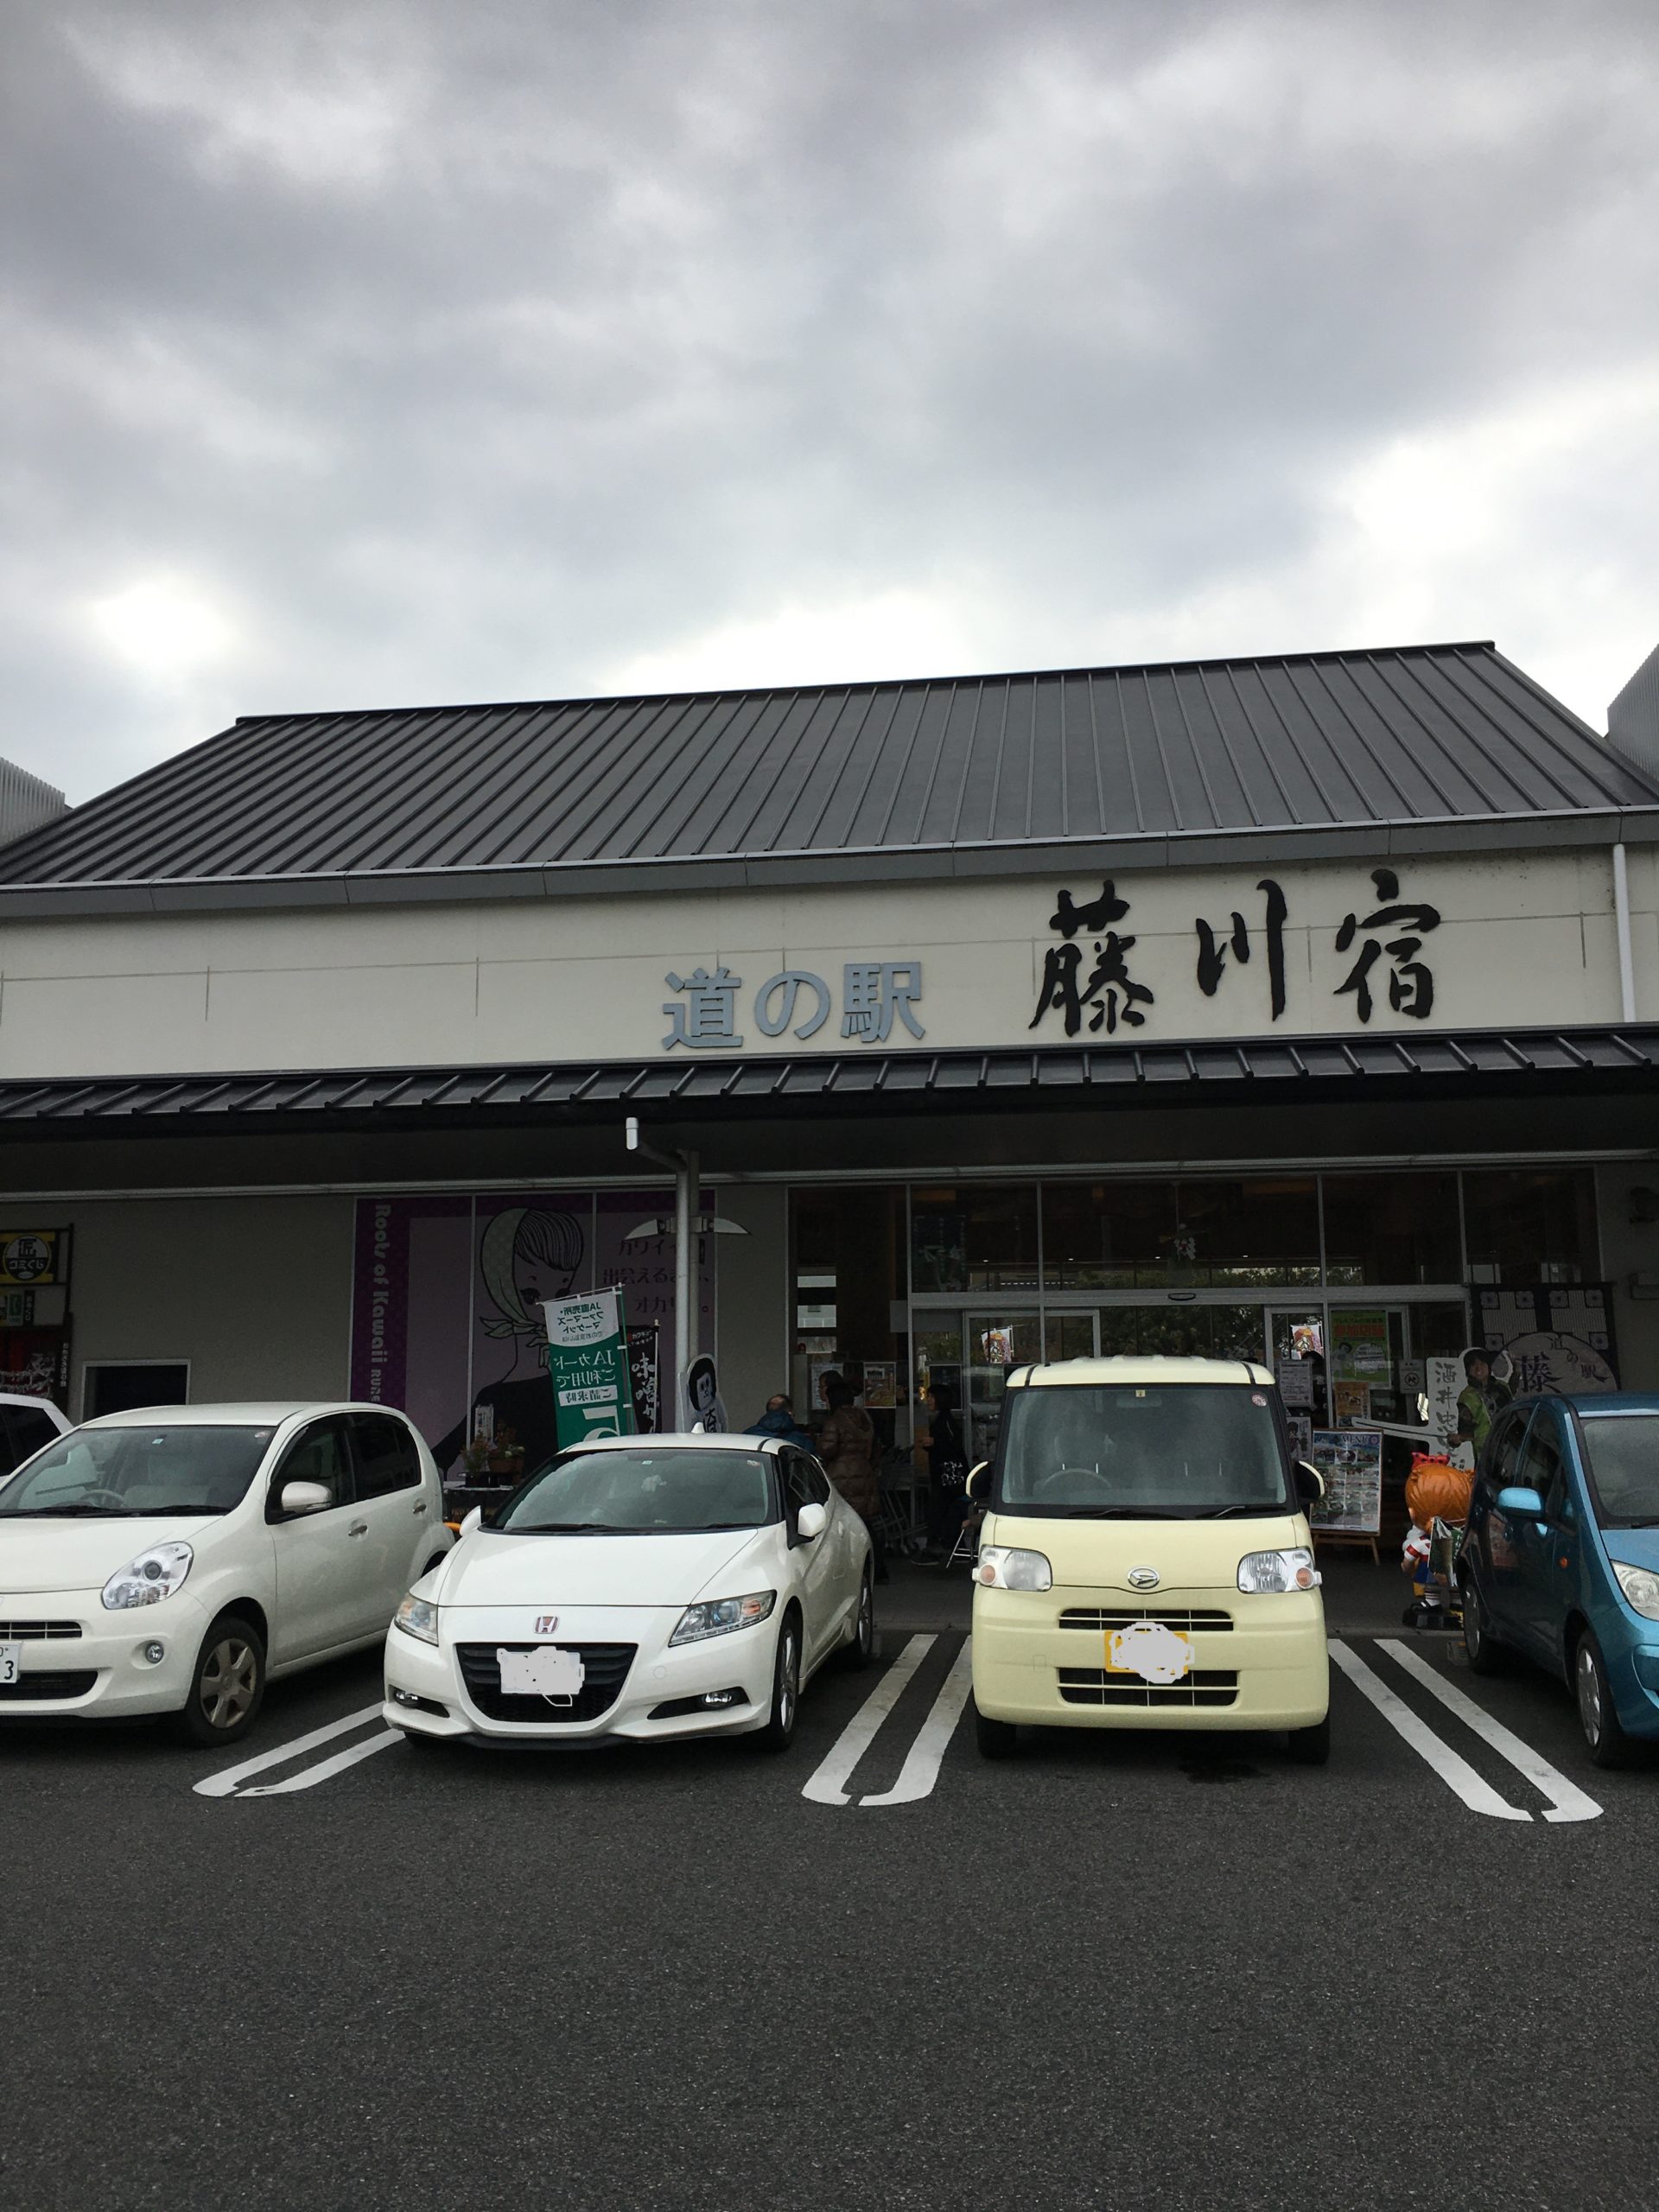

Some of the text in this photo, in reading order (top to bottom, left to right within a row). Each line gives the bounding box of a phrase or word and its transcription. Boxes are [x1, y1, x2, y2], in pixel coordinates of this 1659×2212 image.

[662, 868, 1440, 1050] 道の駅 藤川宿
[373, 1205, 391, 1258] Roots
[373, 1263, 389, 1285] of
[372, 1291, 389, 1363] Kawaii
[1340, 1434, 1370, 1446] MENU
